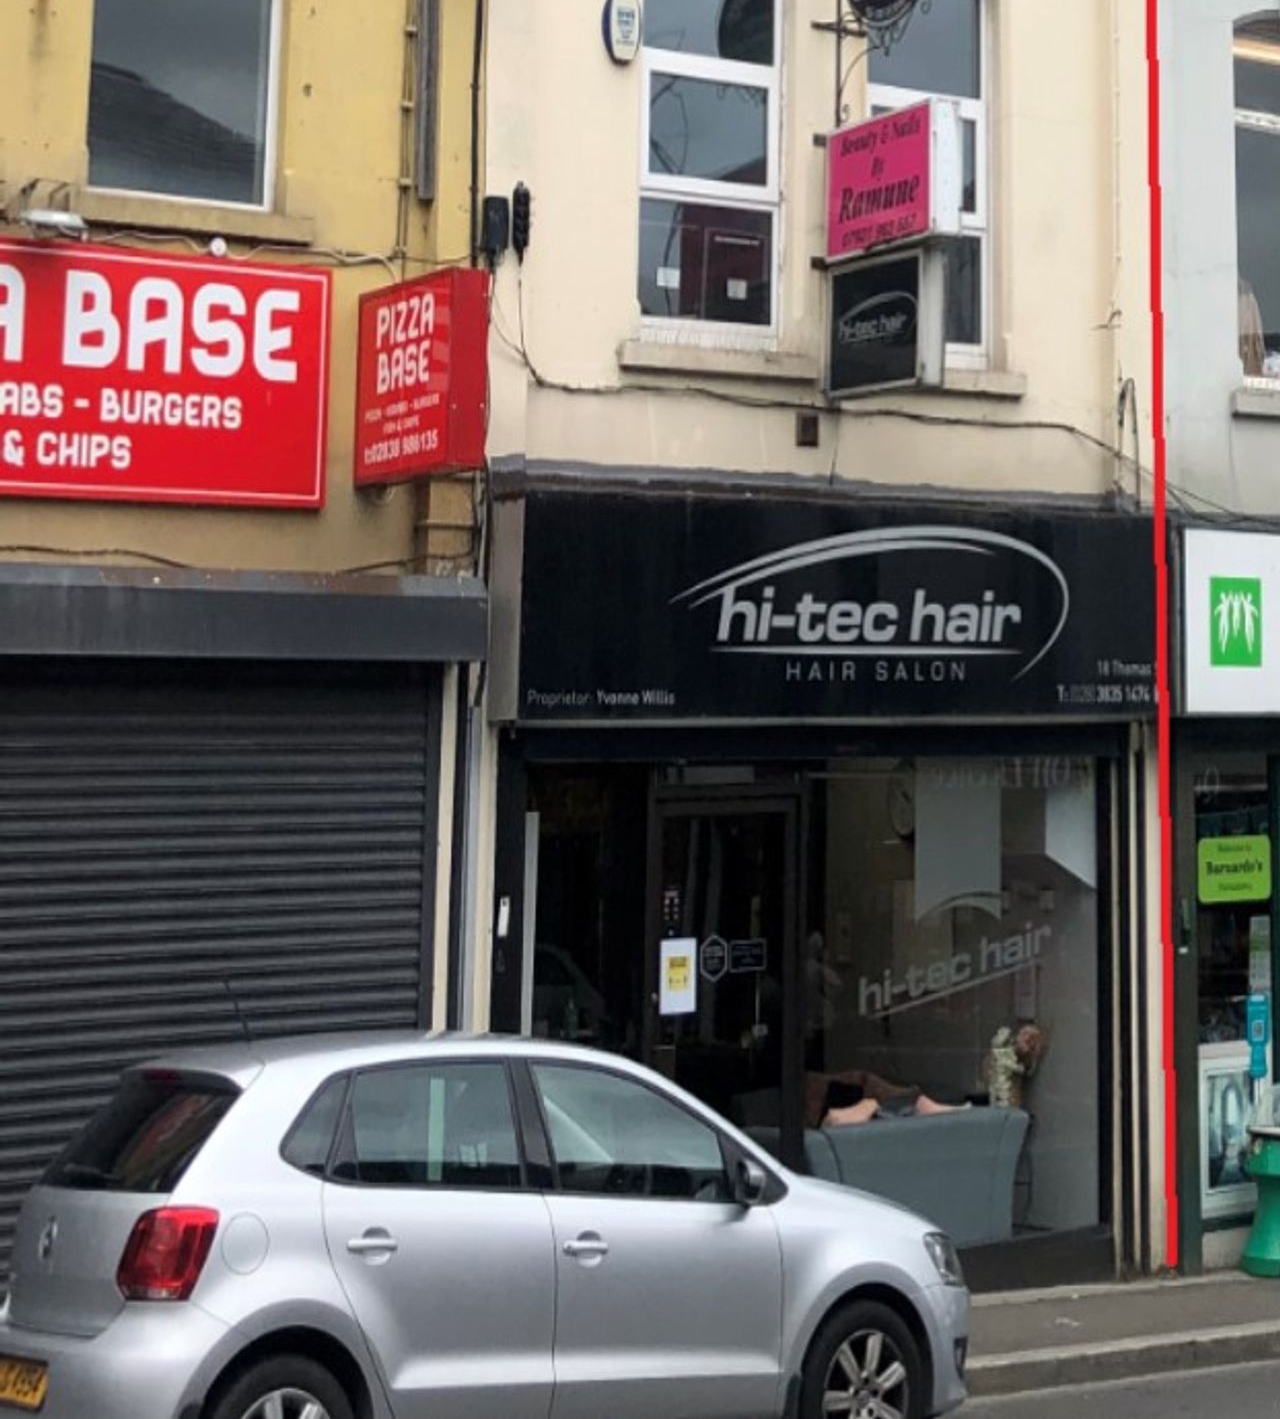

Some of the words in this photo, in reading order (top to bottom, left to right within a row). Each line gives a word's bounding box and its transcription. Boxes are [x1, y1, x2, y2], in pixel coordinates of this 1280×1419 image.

[838, 175, 920, 225] Ramune
[62, 268, 300, 382] BASE
[376, 292, 435, 349] PIZZA
[376, 339, 431, 395] BASE
[100, 387, 242, 429] BURGERS
[3, 429, 24, 467] &
[37, 431, 132, 470] CHIPS
[717, 585, 899, 643] hi-tec
[909, 589, 1022, 643] hair
[597, 688, 640, 705] Yvonne
[642, 688, 676, 705] Willis
[786, 661, 857, 682] HAIR
[875, 661, 967, 682] SALON
[858, 952, 972, 1016] hi-tec
[980, 921, 1051, 973] hair
